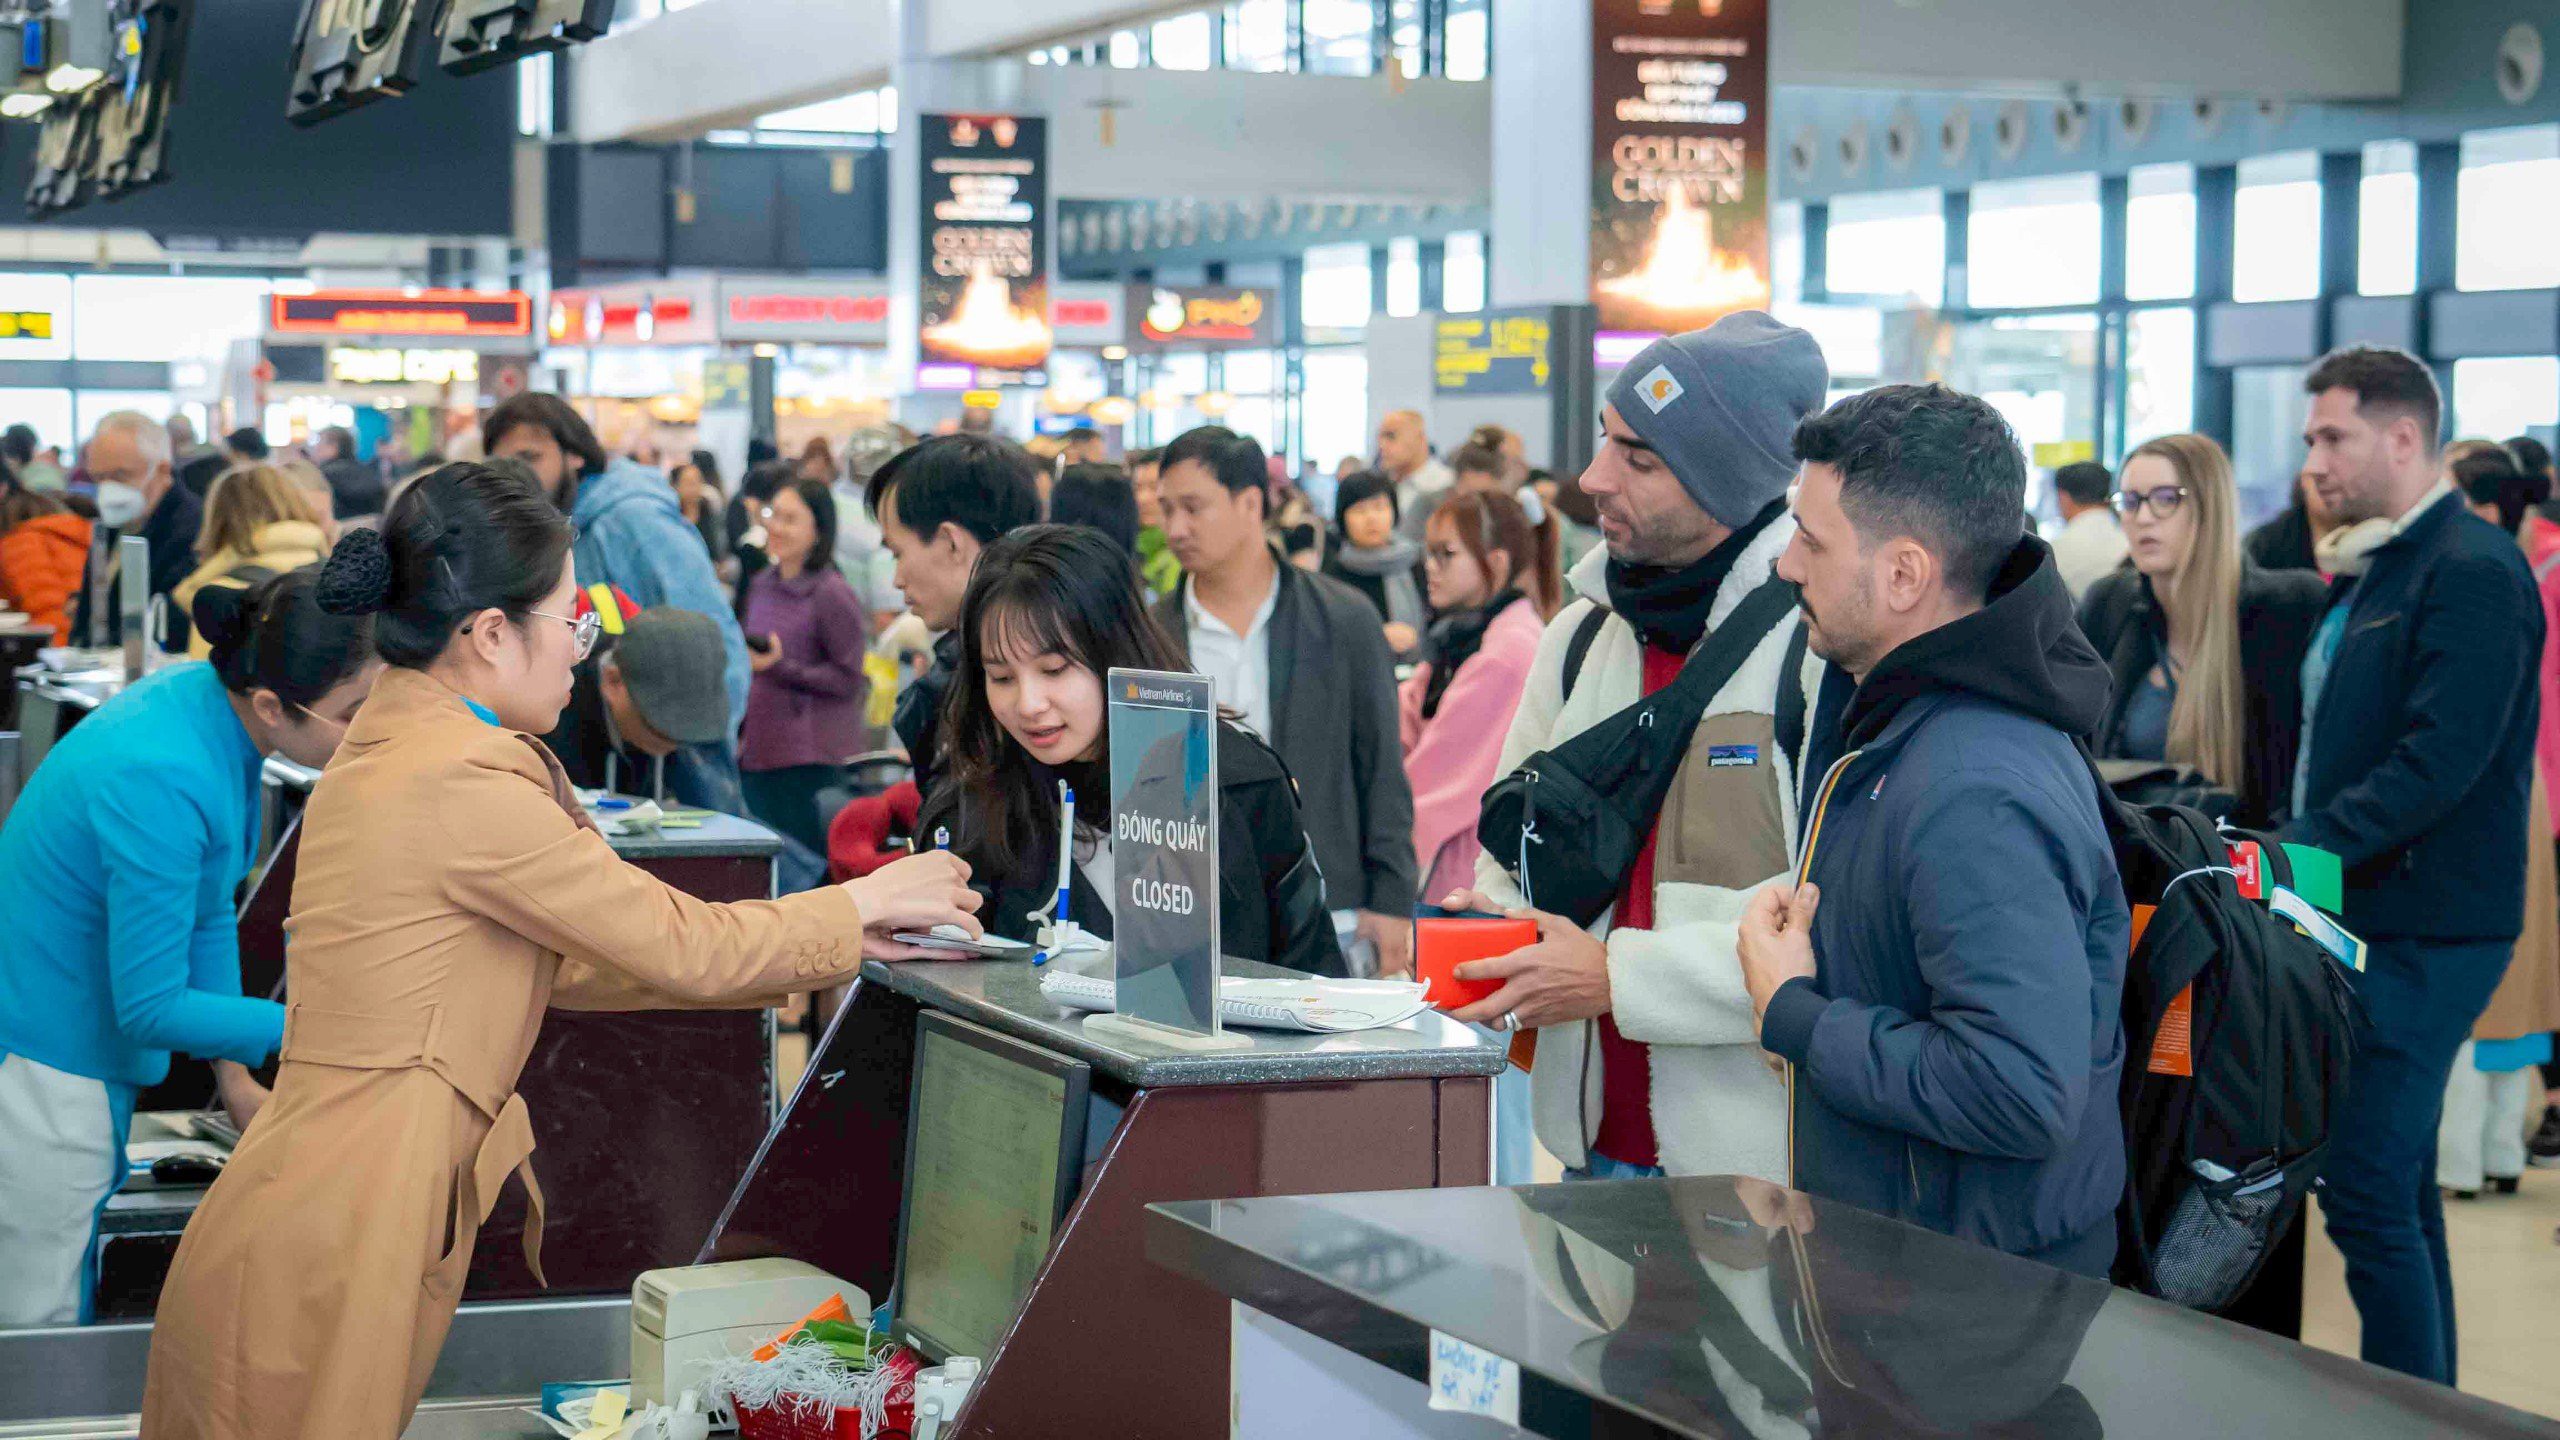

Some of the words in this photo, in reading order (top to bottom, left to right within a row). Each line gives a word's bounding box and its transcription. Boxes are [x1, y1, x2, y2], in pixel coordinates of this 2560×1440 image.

[1139, 685, 1162, 701] Vietnam
[1163, 688, 1184, 702] Airlines
[1711, 757, 1754, 766] patagonia
[1119, 810, 1162, 846] ĐÓNG
[1132, 877, 1194, 915] CLOSED
